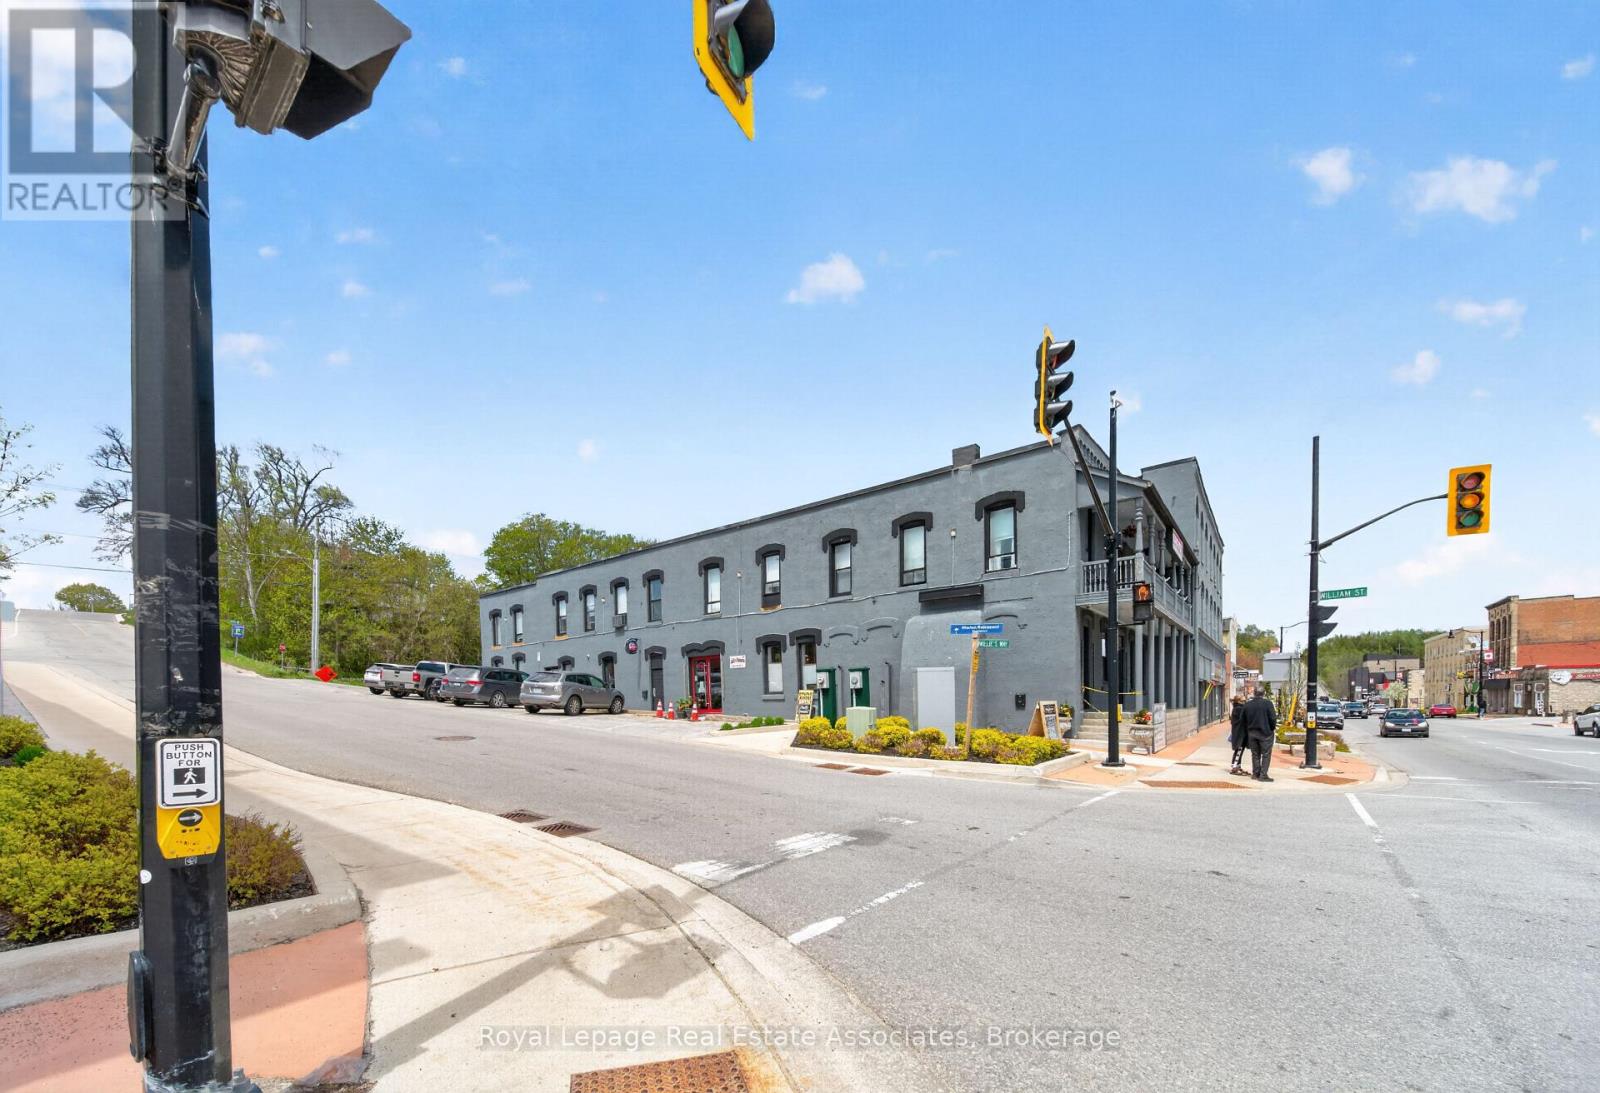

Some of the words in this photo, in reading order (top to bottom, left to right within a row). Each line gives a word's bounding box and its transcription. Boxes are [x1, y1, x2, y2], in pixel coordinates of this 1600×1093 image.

[1320, 590, 1351, 600] WILLIAM
[1355, 588, 1365, 596] ST
[166, 751, 212, 759] BUTTON
